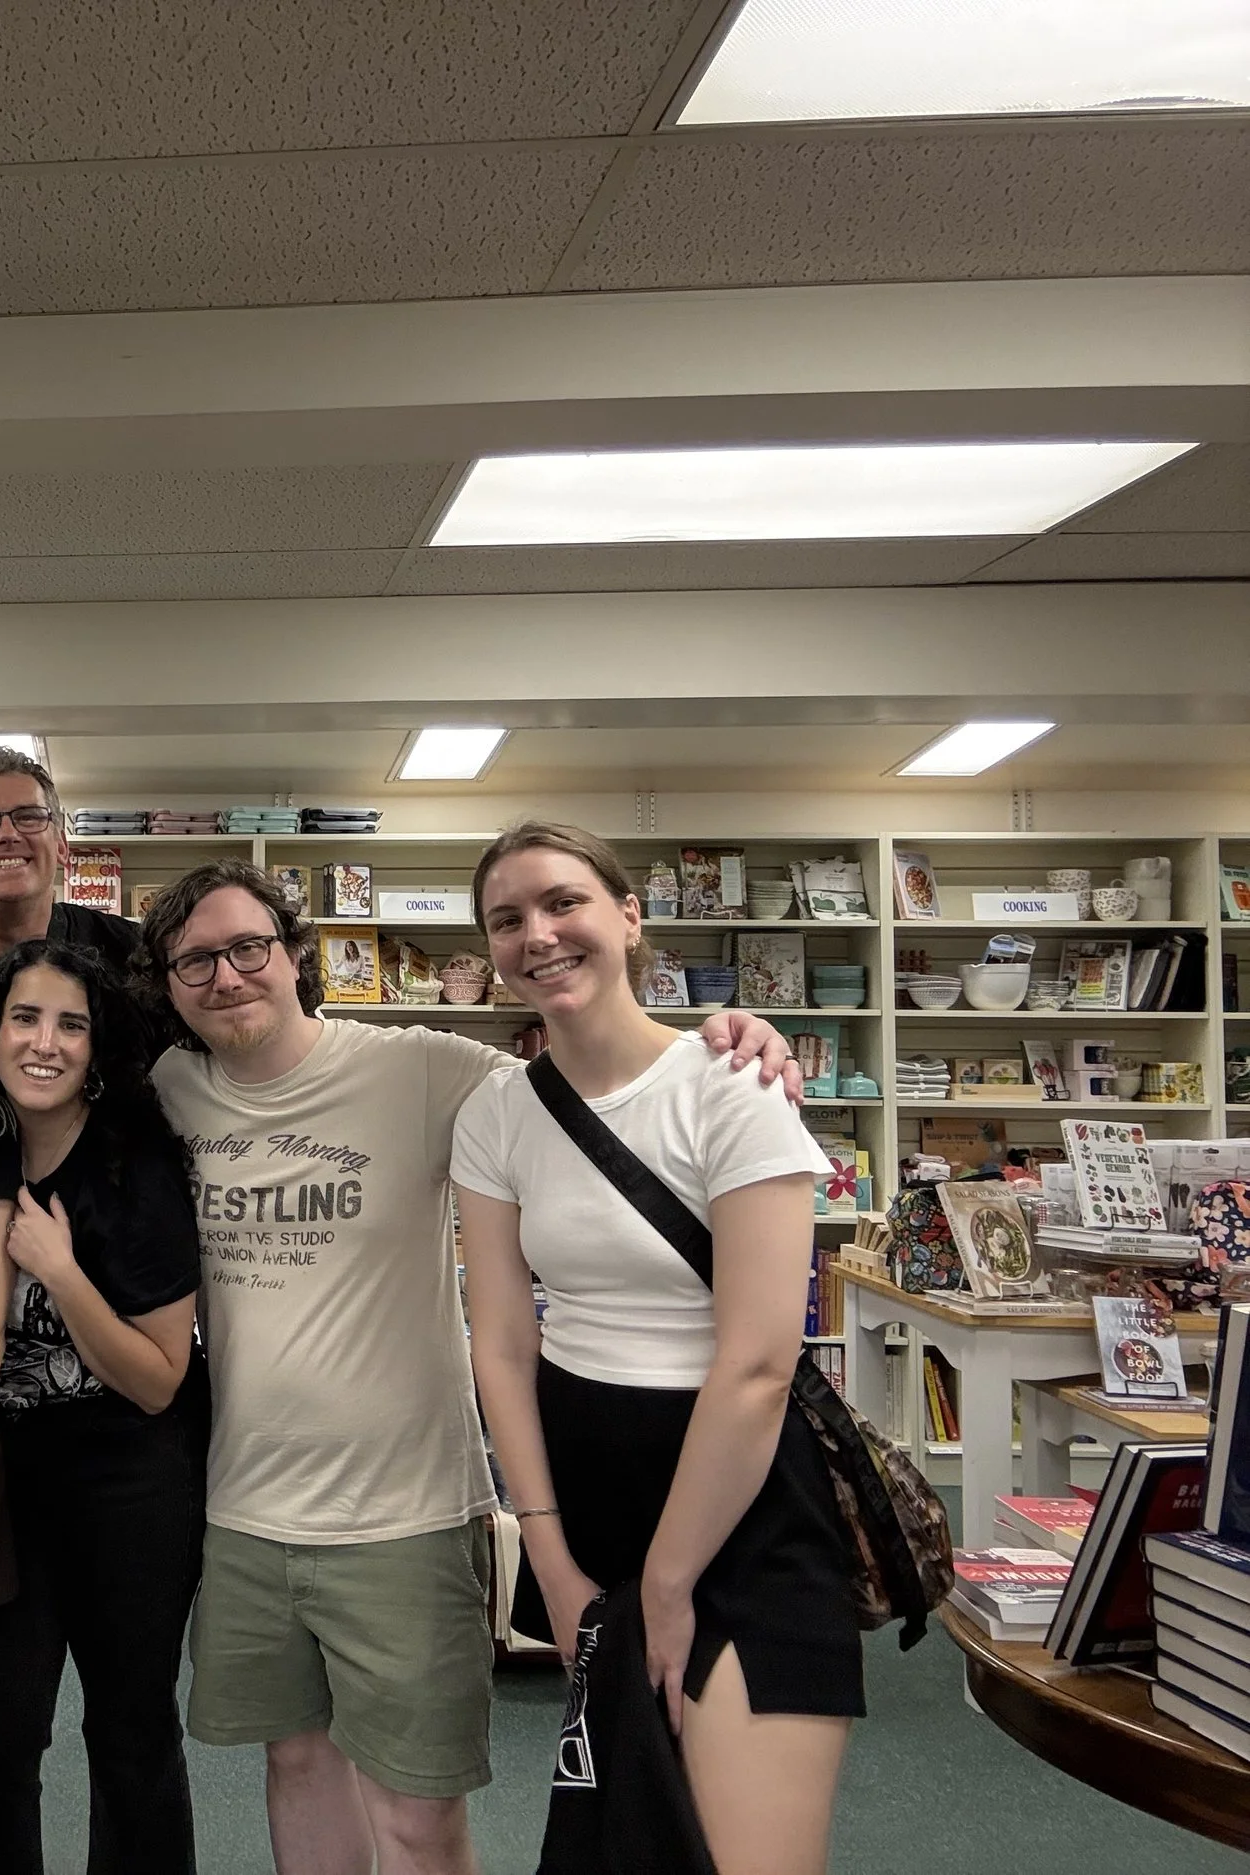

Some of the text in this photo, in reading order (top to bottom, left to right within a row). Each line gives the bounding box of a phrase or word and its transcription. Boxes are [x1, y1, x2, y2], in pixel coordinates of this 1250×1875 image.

[69, 853, 117, 866] upside
[69, 873, 117, 886] down
[406, 900, 445, 911] COOKING
[1003, 900, 1048, 913] COOKING
[268, 1134, 372, 1175] Morning
[1095, 1153, 1137, 1164] VEGETABLE
[1105, 1163, 1132, 1174] GENIUS
[955, 1190, 977, 1198] SALAD
[200, 1229, 239, 1243] FROM
[280, 1231, 335, 1246] STUDIO
[1111, 1236, 1135, 1244] VEGETABLE
[218, 1247, 257, 1263] UNION
[263, 1250, 318, 1266] AVENUE
[1124, 1303, 1146, 1312] THE
[1118, 1317, 1157, 1327] LITTLE
[1122, 1331, 1158, 1339] BOOK
[1134, 1345, 1150, 1353] OF
[1127, 1359, 1162, 1368] BOWL
[1130, 1373, 1164, 1382] FOOD
